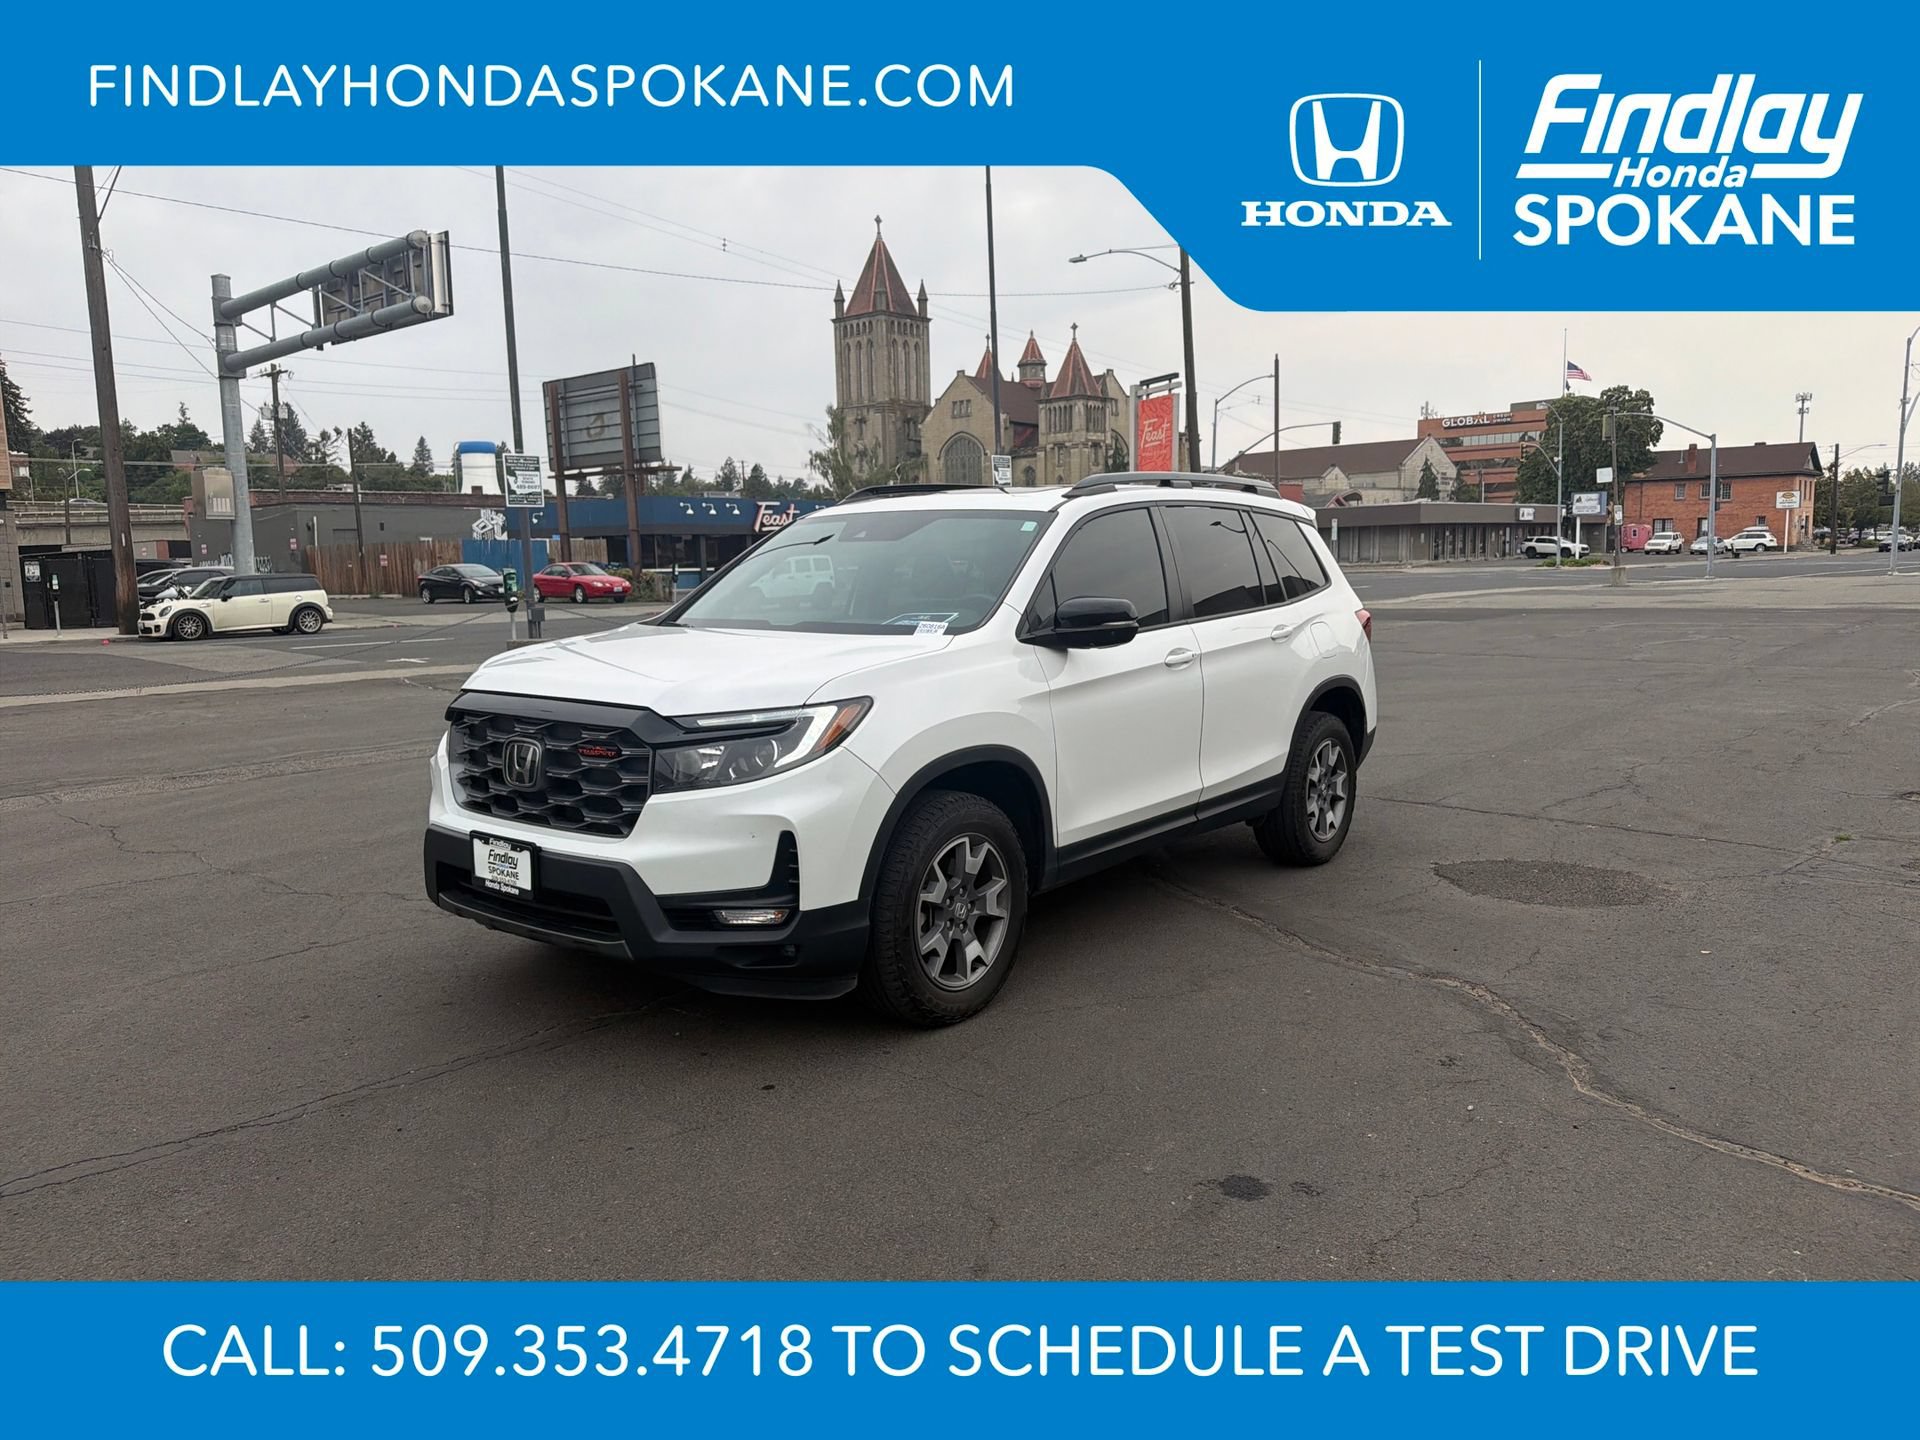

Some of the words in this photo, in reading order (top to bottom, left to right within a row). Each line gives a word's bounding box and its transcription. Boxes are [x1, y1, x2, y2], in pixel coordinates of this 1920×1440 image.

[1442, 415, 1490, 428] GLOBAL
[1141, 418, 1170, 449] Feast
[753, 501, 800, 533] Feast
[488, 849, 519, 869] Findlay
[488, 866, 520, 880] SPOKANE
[485, 880, 500, 890] Honda
[500, 883, 519, 895] Spokane
